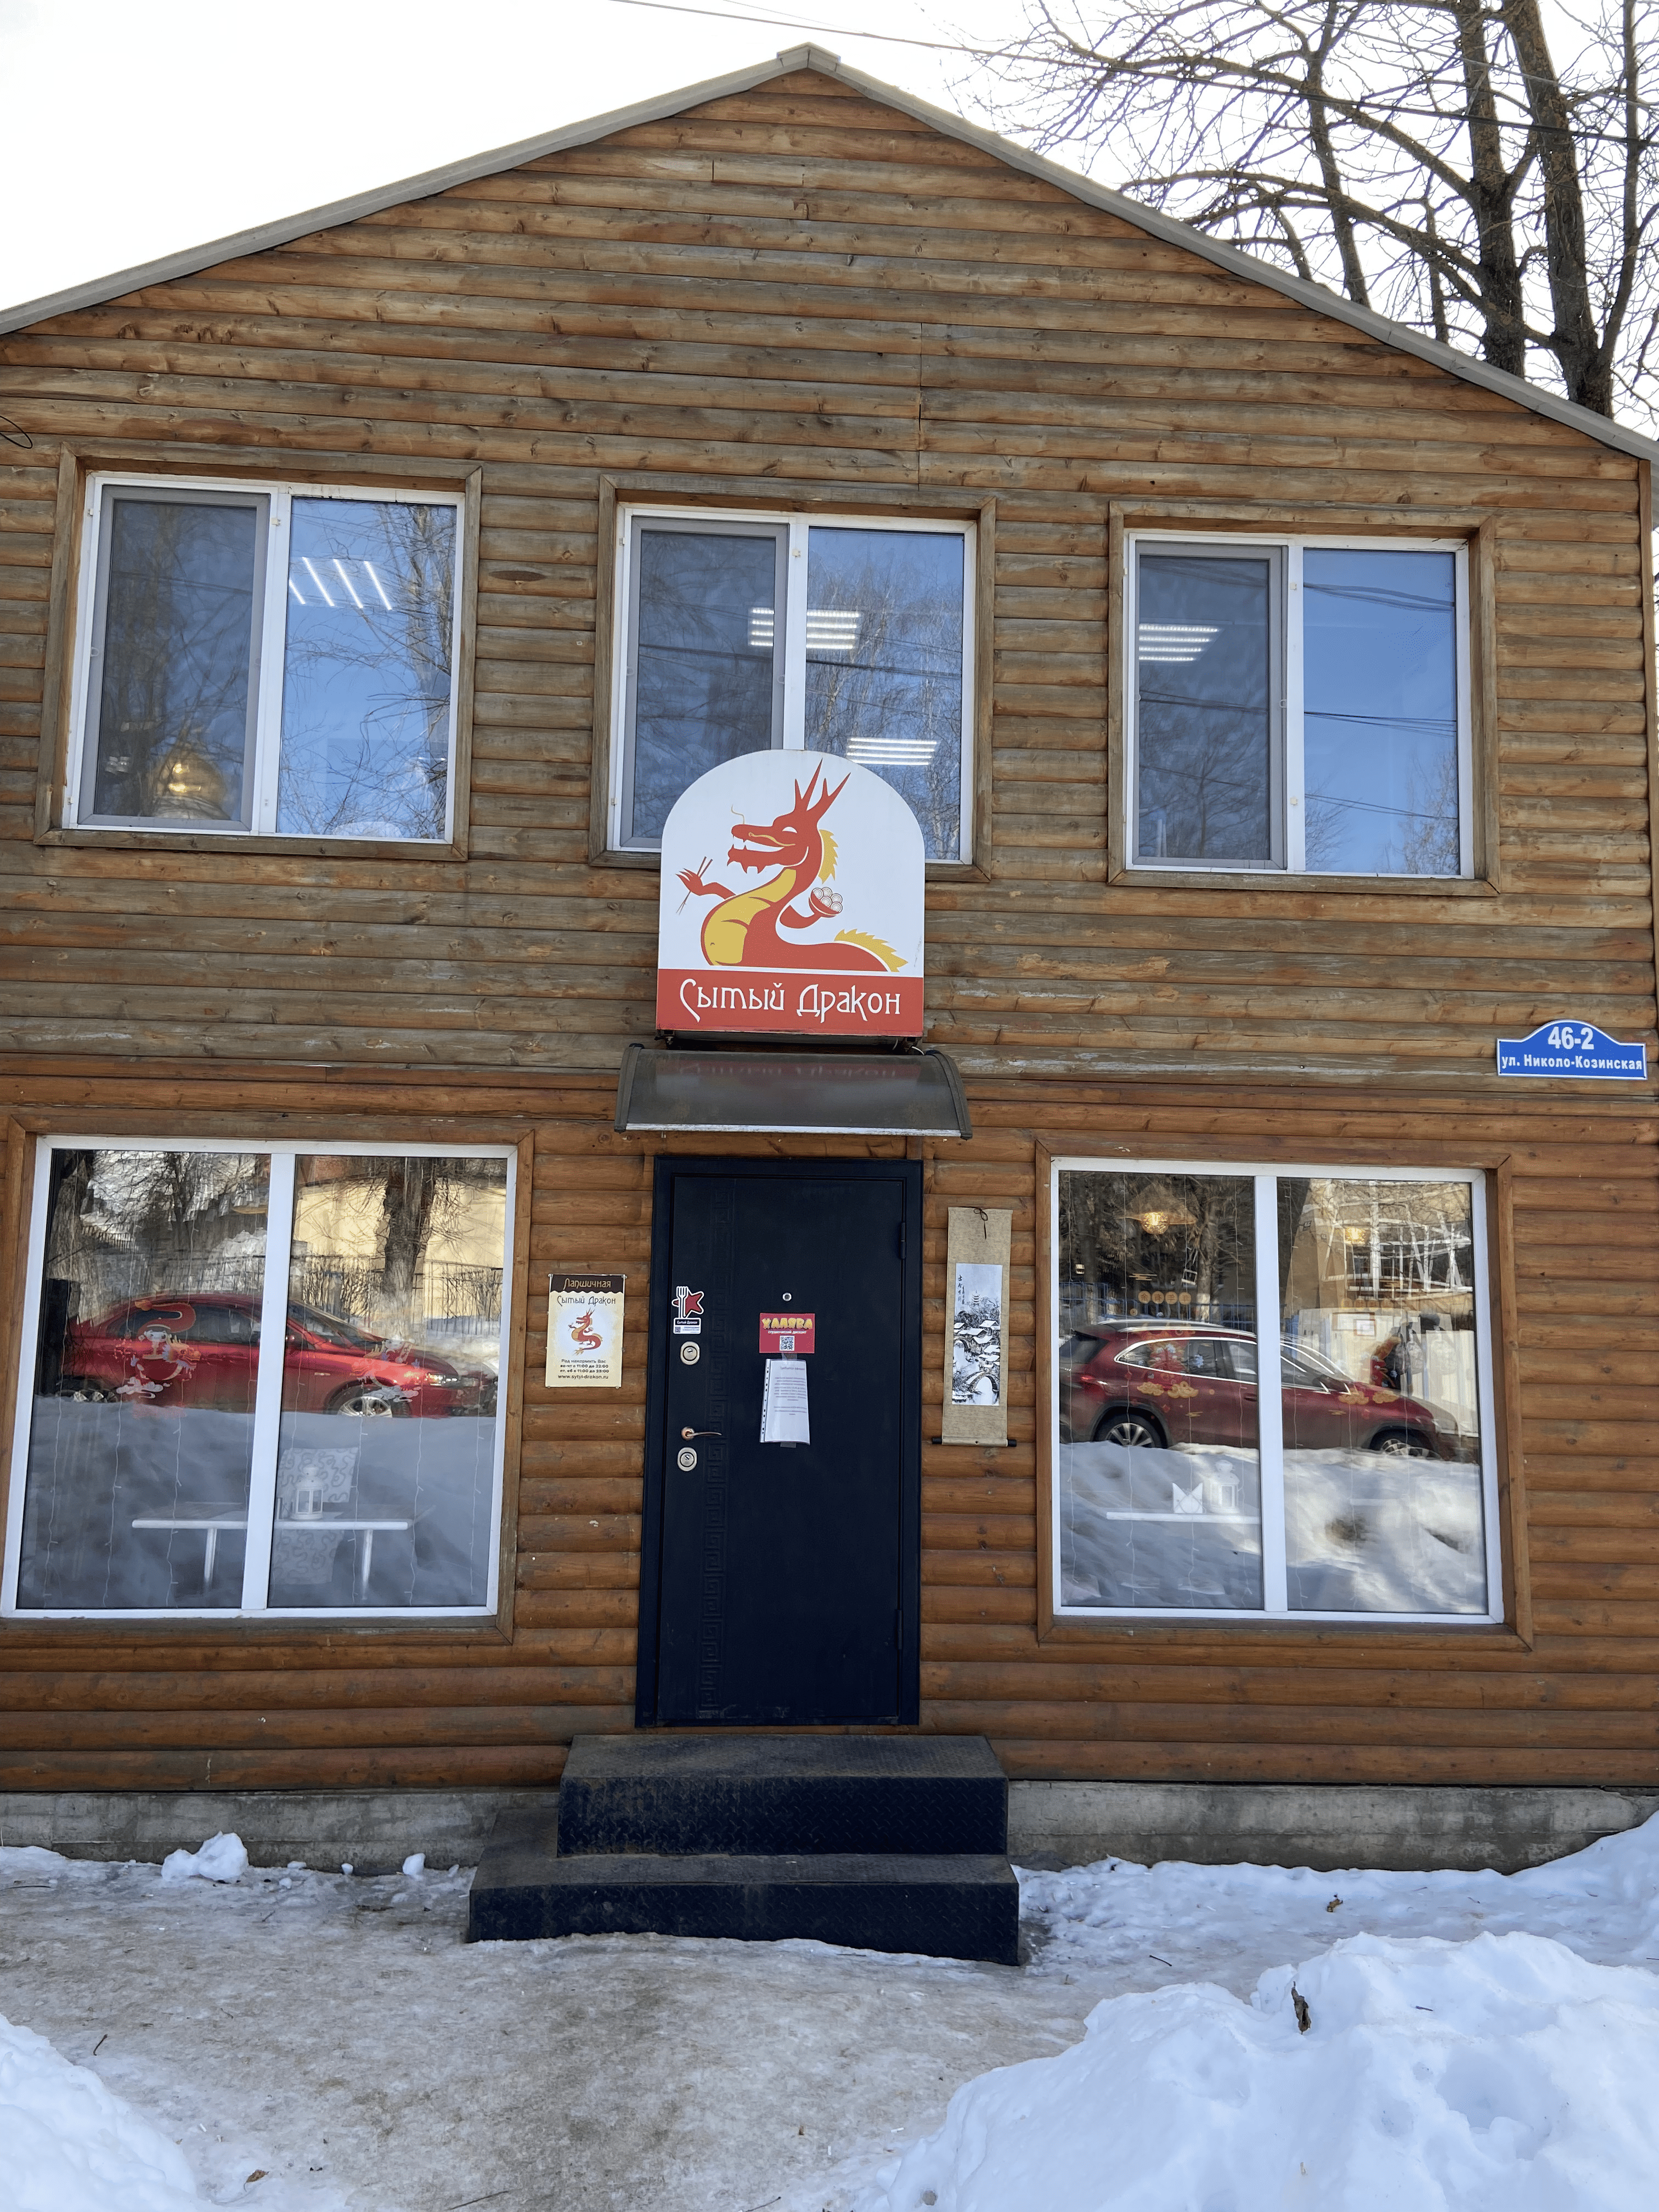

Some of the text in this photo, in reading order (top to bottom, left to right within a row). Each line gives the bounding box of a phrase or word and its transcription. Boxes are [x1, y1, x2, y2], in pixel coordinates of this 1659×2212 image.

[679, 978, 900, 1023] Сытый Дракон
[1547, 1026, 1594, 1050] 46-2
[1502, 1054, 1643, 1070] ул. Николо-Козинская
[563, 1278, 611, 1290] Лапшичная
[557, 1295, 616, 1307] Сытый Дракон
